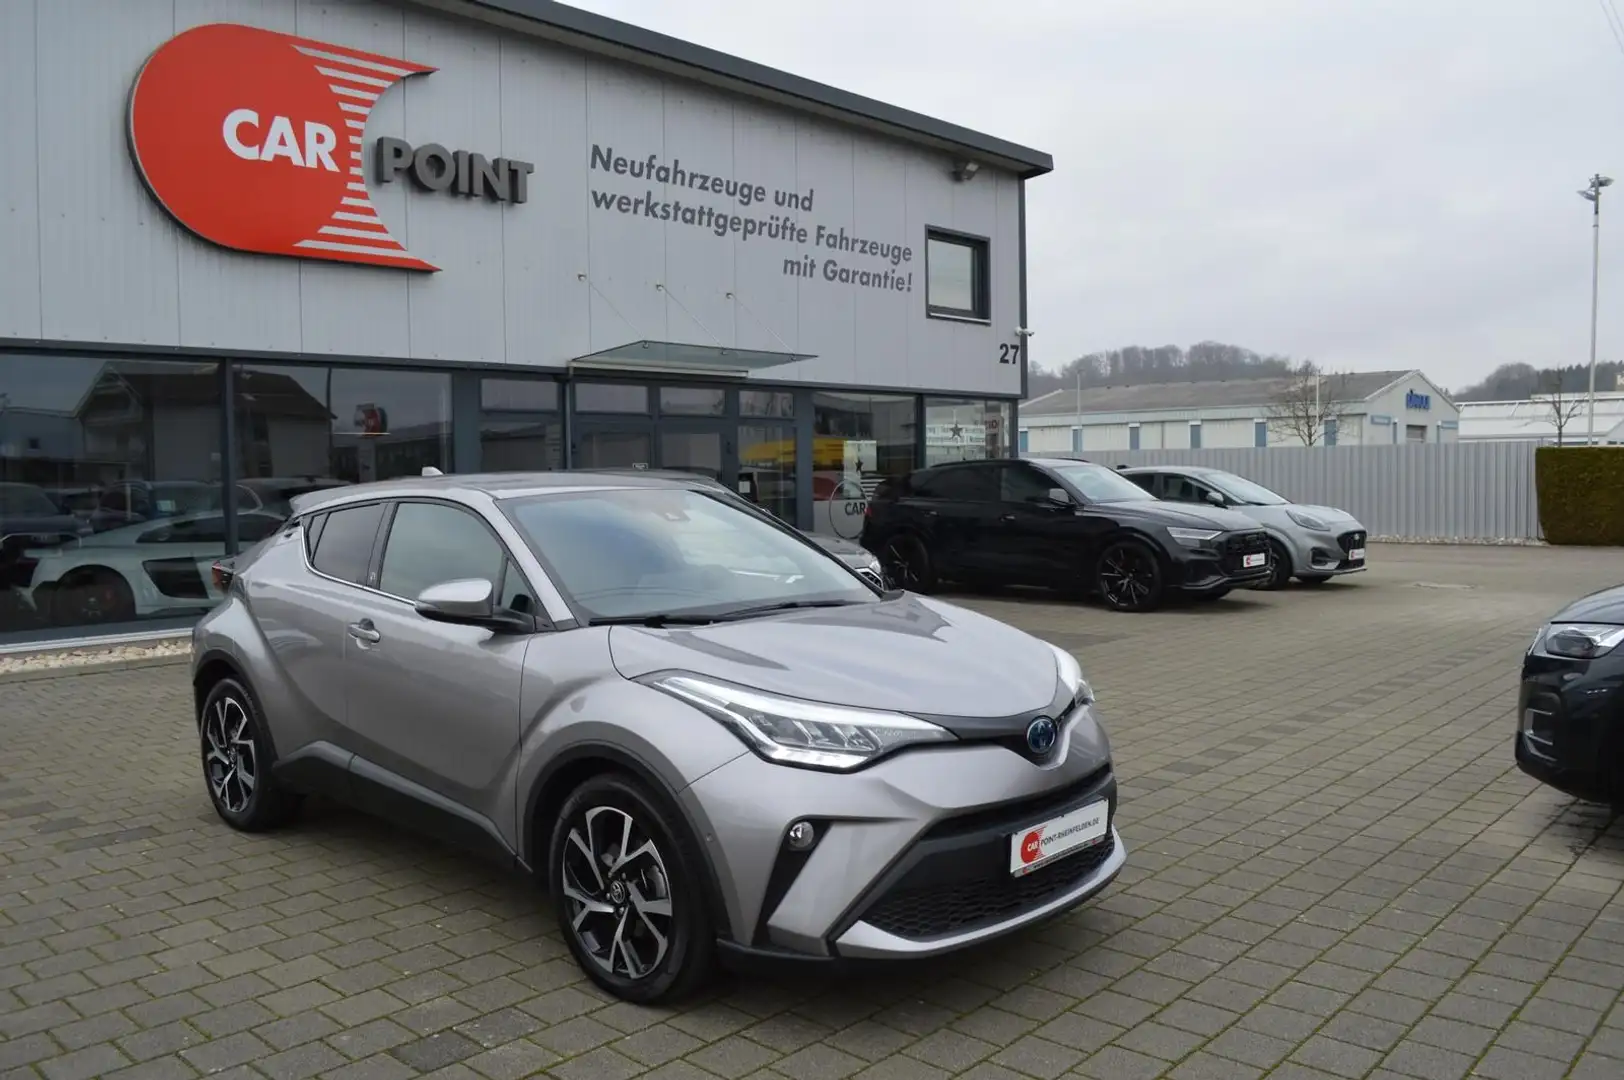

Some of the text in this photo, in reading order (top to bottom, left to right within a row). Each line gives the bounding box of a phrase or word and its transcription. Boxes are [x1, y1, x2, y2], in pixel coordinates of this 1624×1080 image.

[222, 108, 535, 204] CAR POINT
[590, 143, 815, 212] Neufahrzeuge und
[591, 189, 913, 267] werkstattgeprüfte Fahrzeuge
[782, 254, 913, 292] mit Garantie!
[999, 342, 1020, 365] 27
[844, 501, 866, 516] CAR
[1027, 840, 1039, 852] CAR
